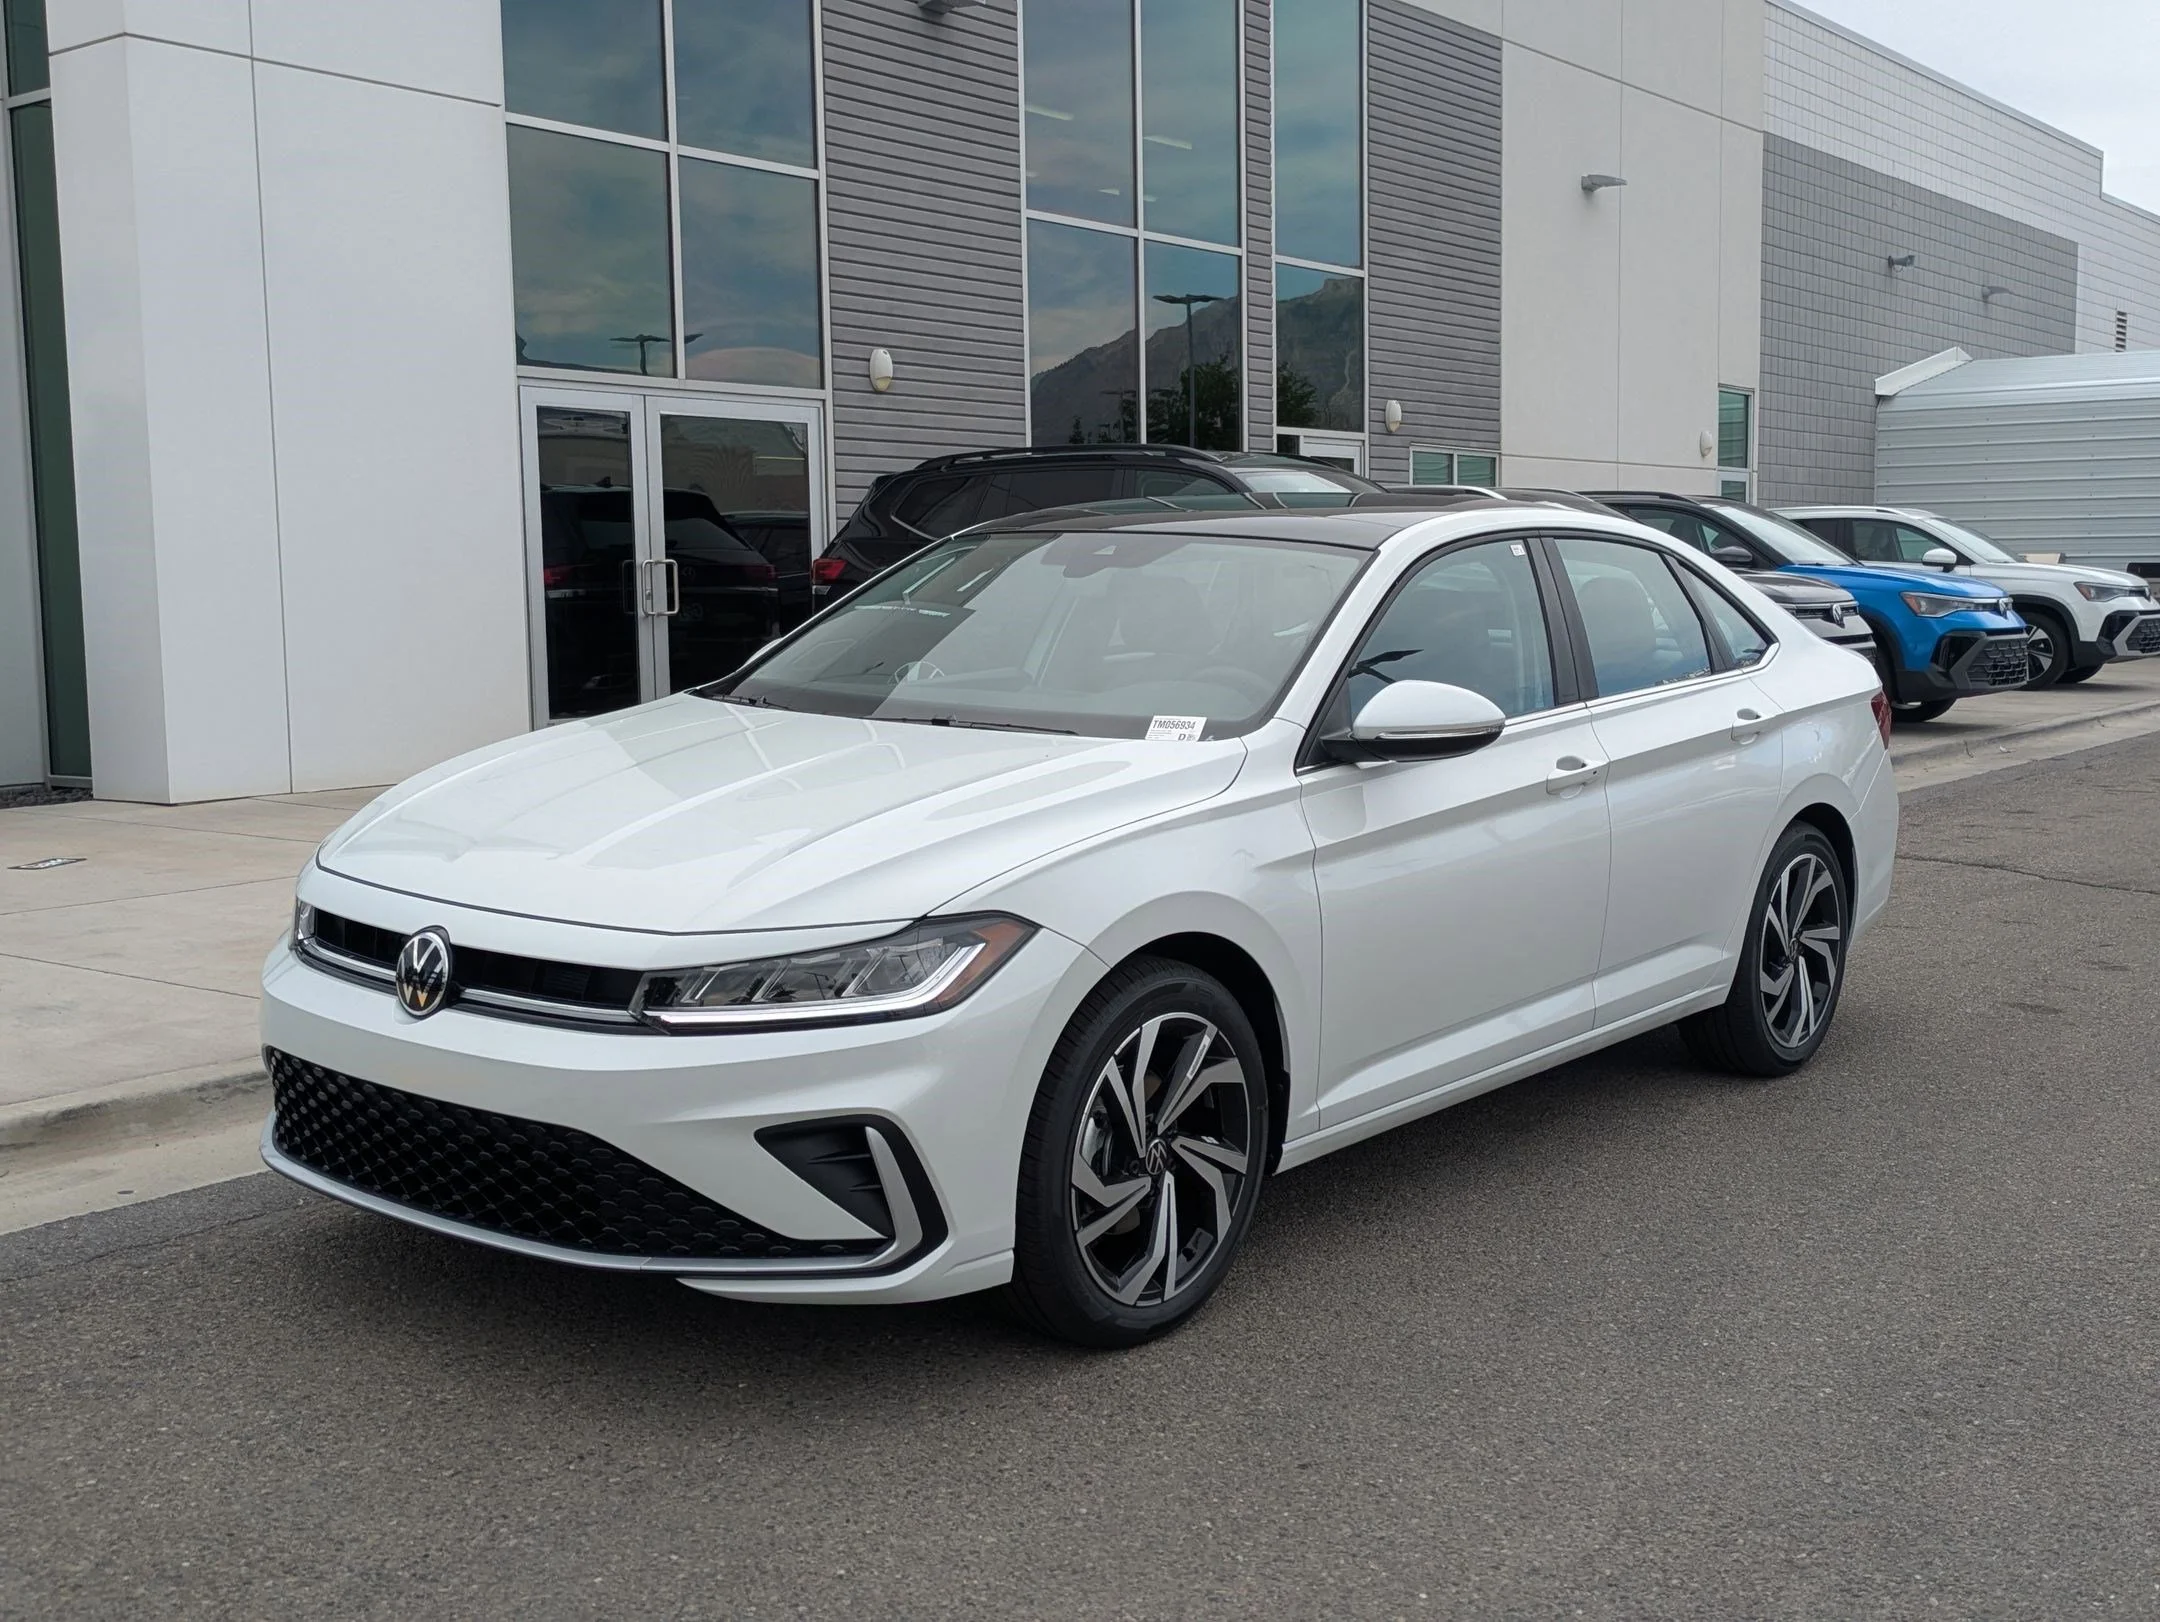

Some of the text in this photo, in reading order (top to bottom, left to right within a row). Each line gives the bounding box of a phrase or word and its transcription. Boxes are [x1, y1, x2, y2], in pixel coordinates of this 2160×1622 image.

[1152, 720, 1197, 730] TM056934
[1177, 733, 1187, 741] D
[396, 932, 448, 1016] VW
